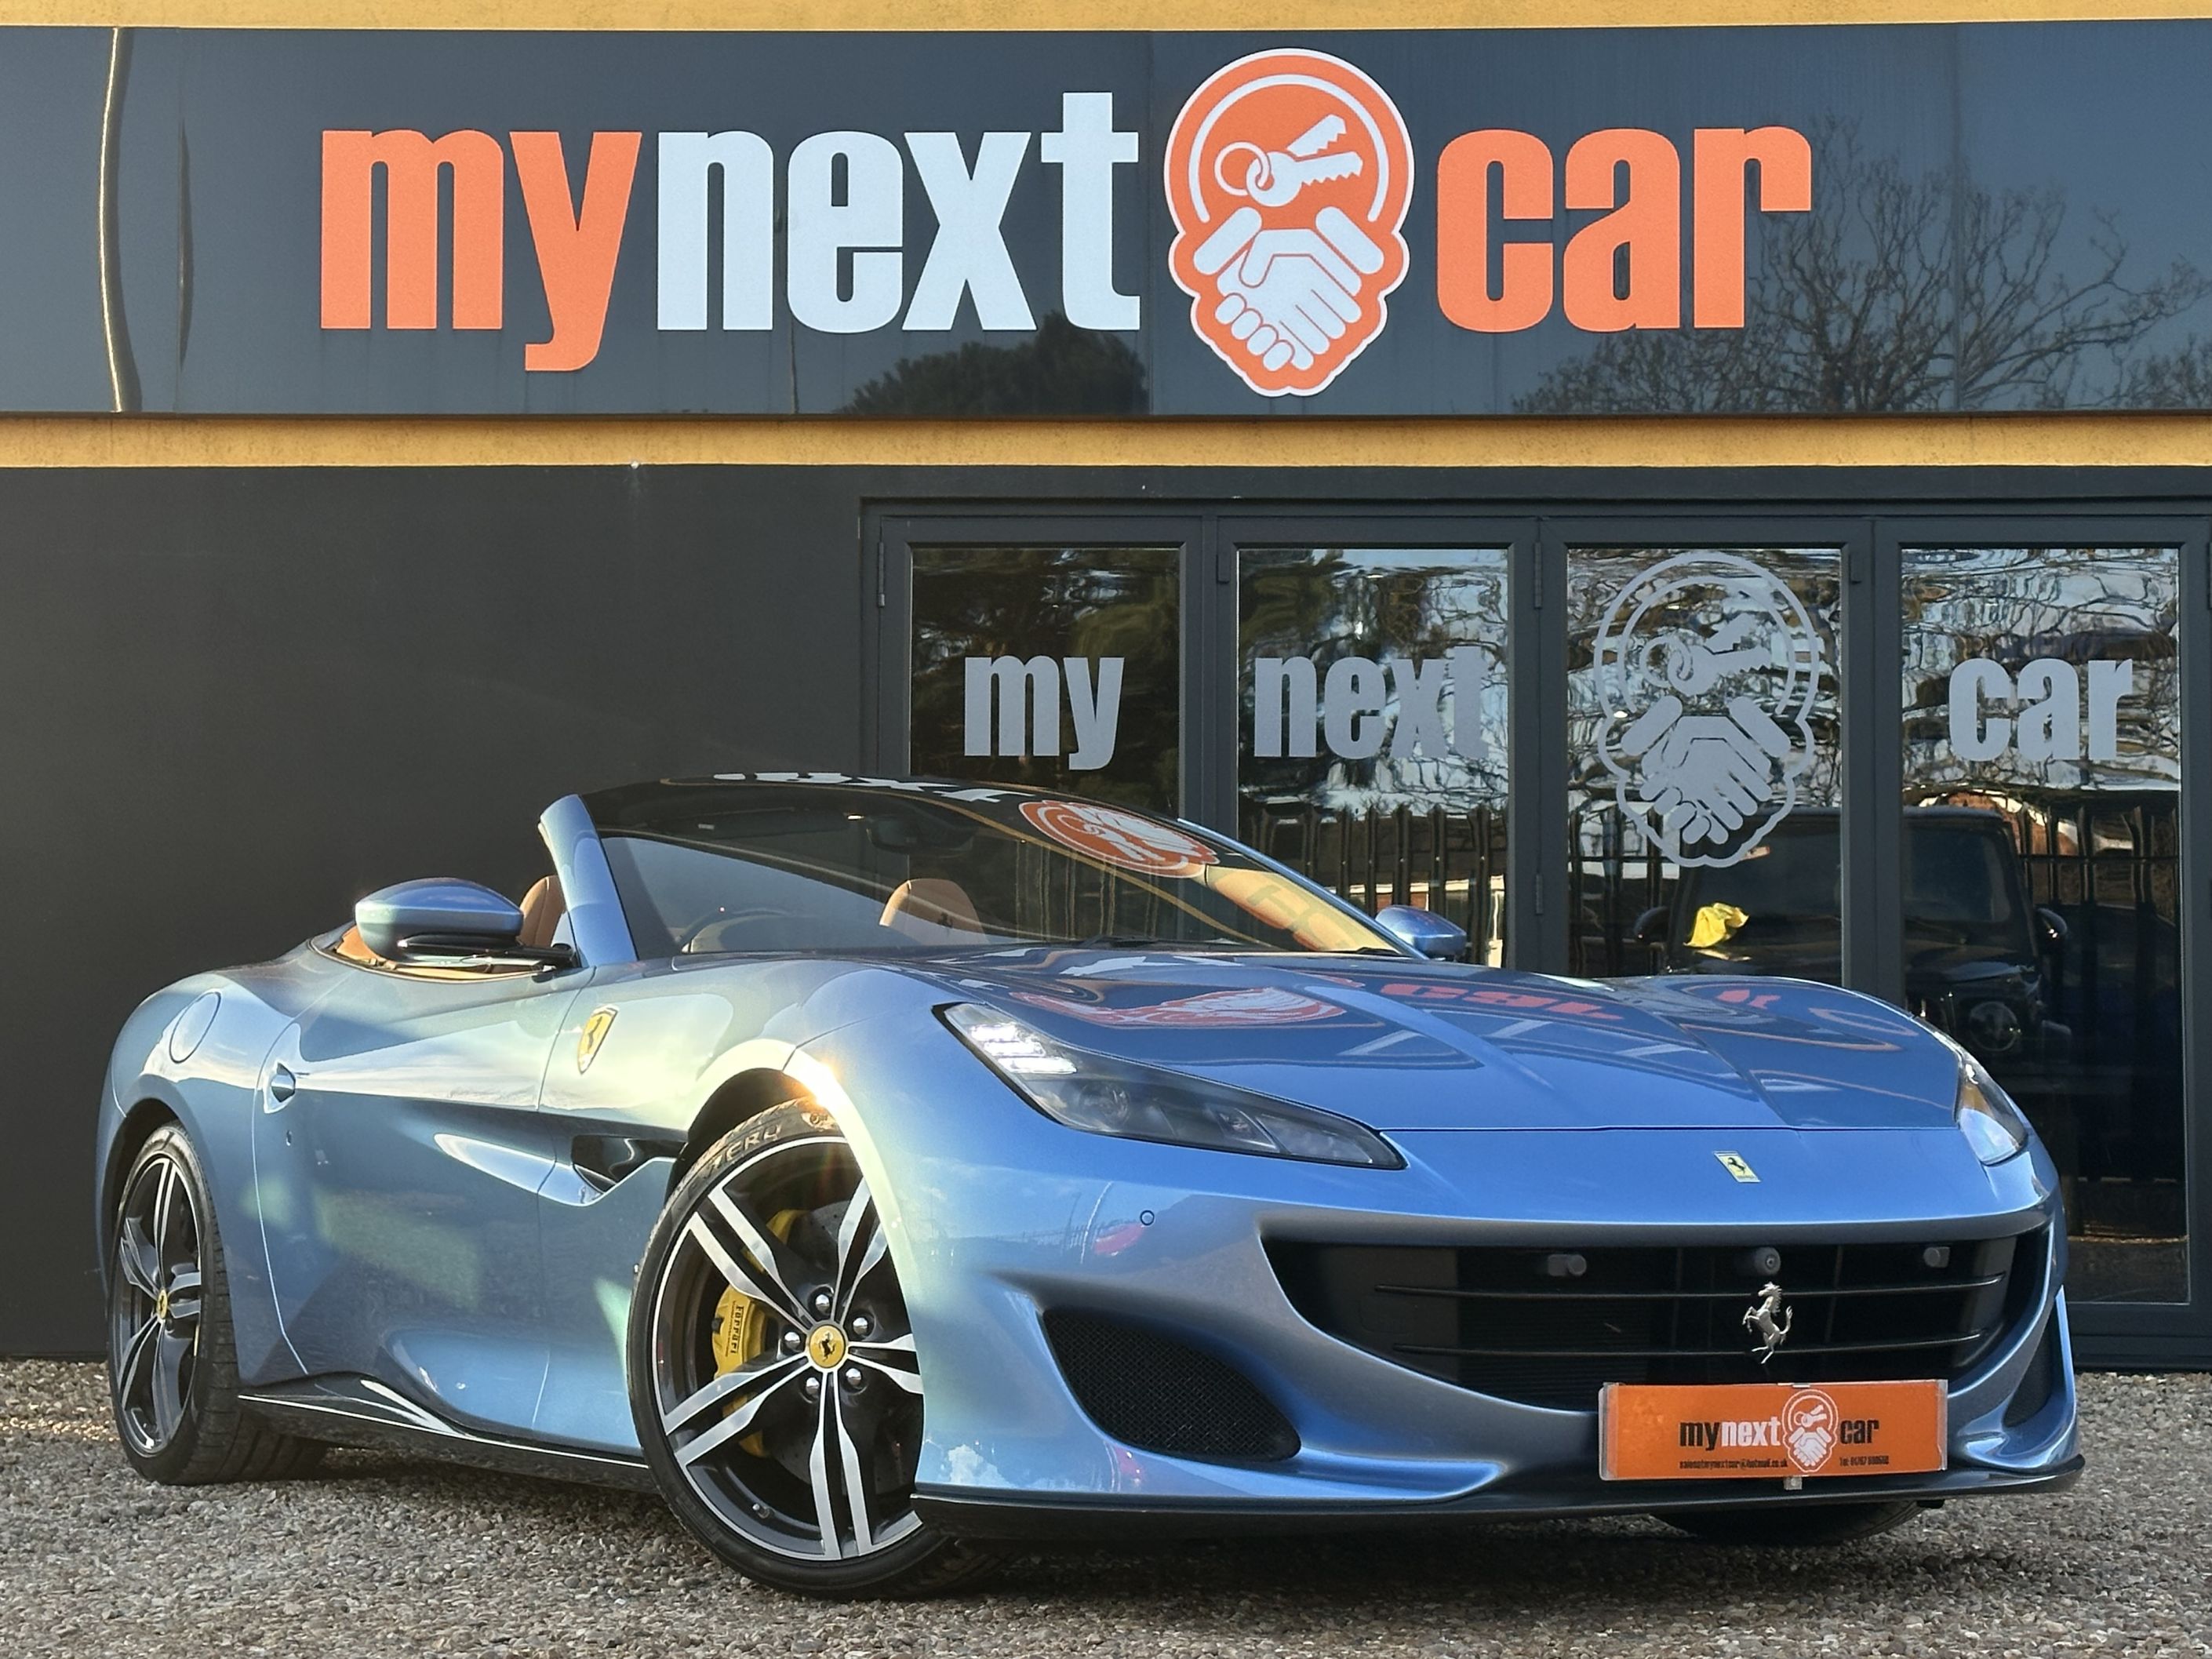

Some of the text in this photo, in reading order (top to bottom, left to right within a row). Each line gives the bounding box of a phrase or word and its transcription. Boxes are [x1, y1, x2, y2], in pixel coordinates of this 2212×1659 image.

[1438, 127, 1810, 332] car
[965, 647, 2133, 769] my next car
[729, 1304, 745, 1355] Ferrari
[1839, 1419, 1879, 1444] car
